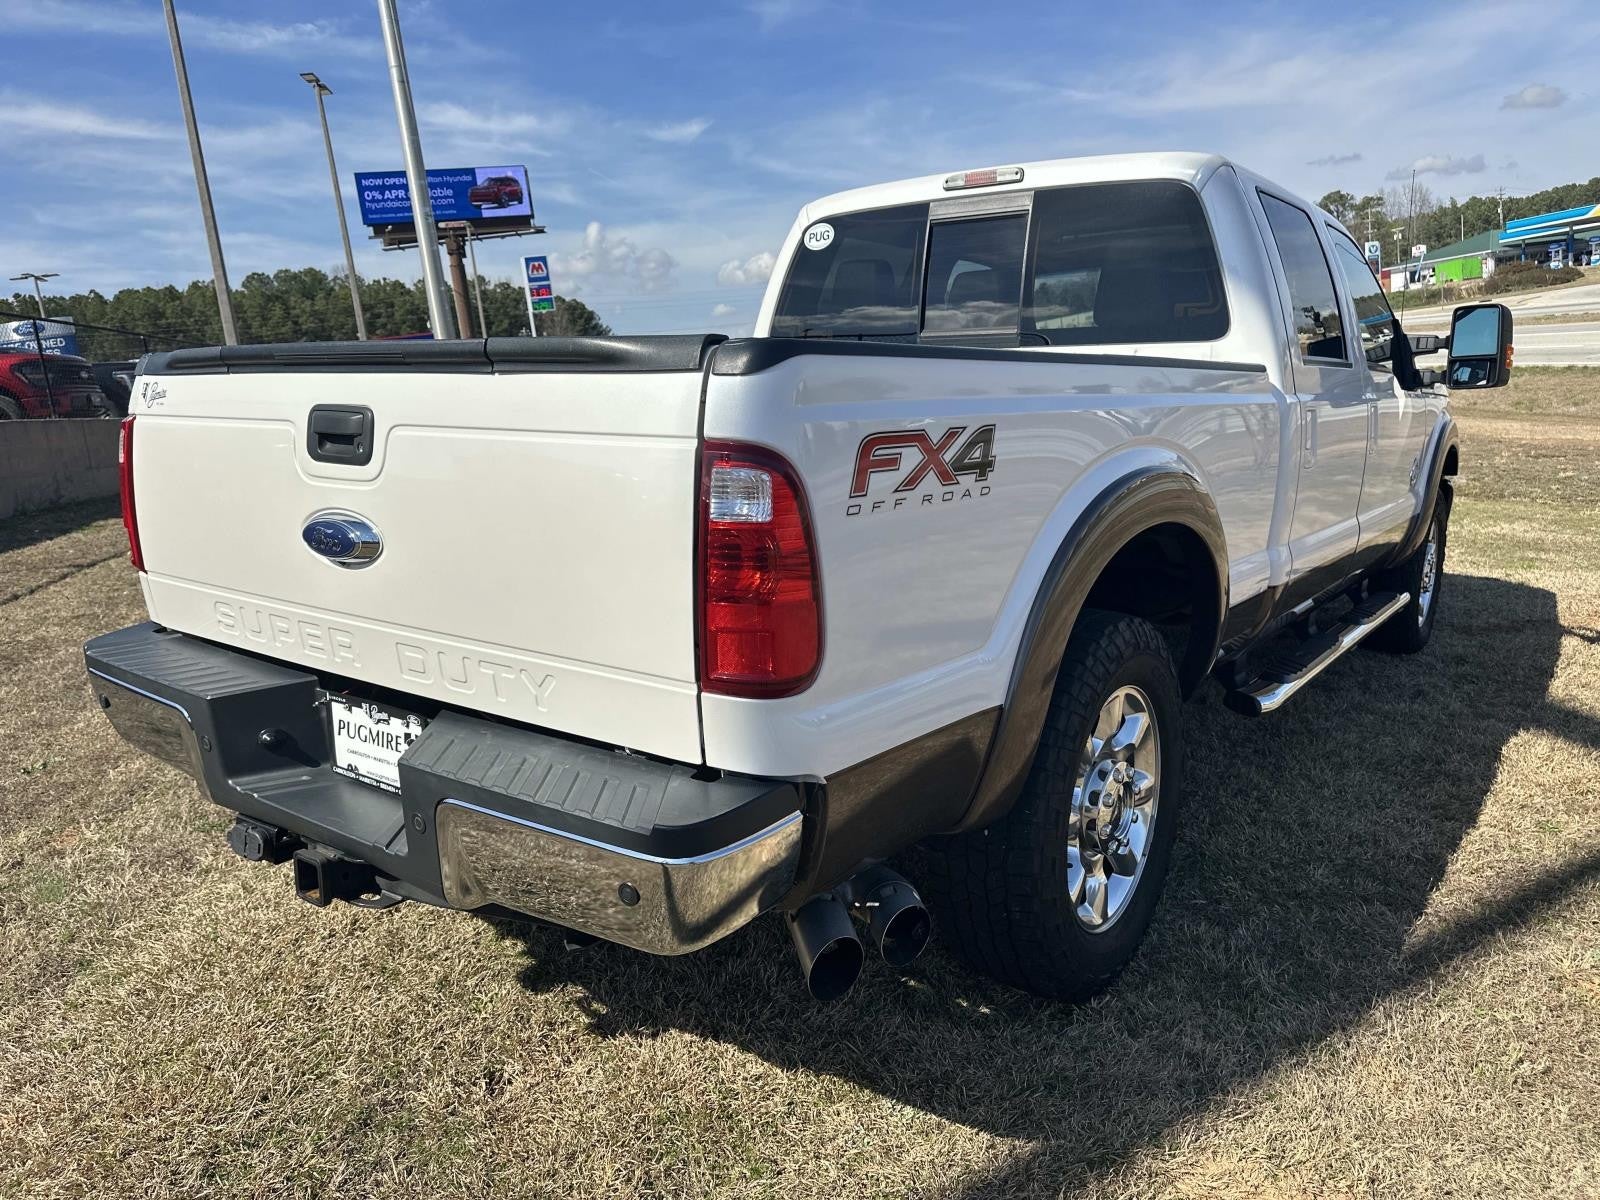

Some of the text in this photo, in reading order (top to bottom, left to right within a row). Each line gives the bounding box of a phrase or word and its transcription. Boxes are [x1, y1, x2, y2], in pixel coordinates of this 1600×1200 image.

[362, 178, 383, 187] NOW
[384, 177, 407, 186] OPEN
[443, 174, 472, 184] Hyundai
[364, 190, 383, 200] 0%
[384, 189, 406, 199] APR
[807, 230, 831, 244] PUG
[848, 424, 997, 499] FX4
[846, 486, 992, 516] OFF ROAD
[214, 600, 557, 713] SUPER DUTY
[337, 719, 402, 754] PUGMIRE
